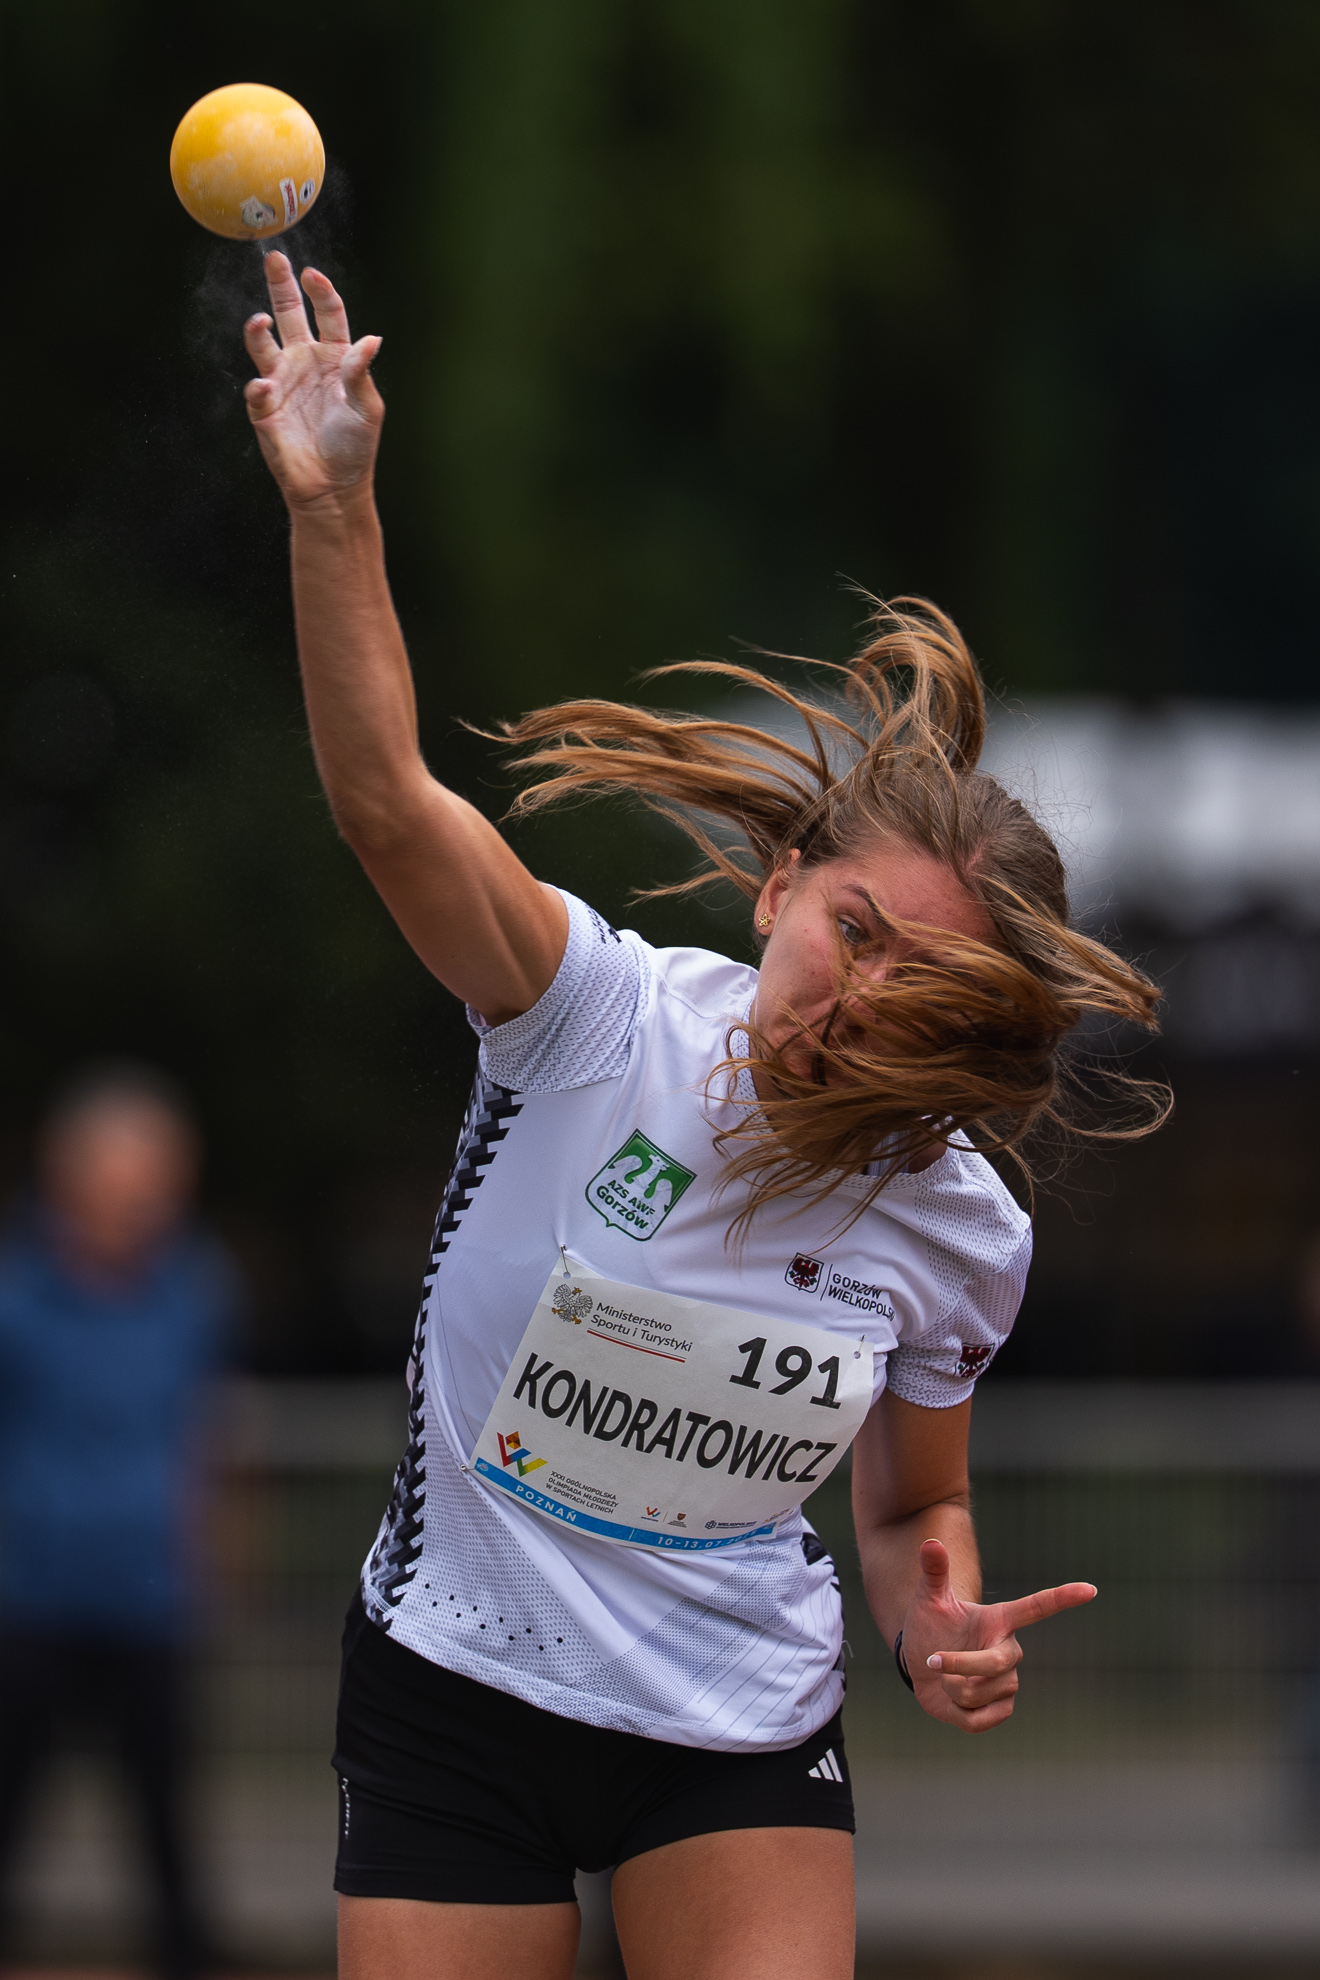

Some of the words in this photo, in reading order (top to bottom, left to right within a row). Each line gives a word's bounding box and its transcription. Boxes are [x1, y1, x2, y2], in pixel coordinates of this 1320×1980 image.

[608, 1180, 629, 1199] AZS
[628, 1197, 655, 1216] AWF
[832, 1273, 882, 1300] GORZÓW
[591, 1314, 630, 1335] Sportu
[632, 1327, 638, 1337] i
[640, 1329, 693, 1352] Turystyki
[596, 1302, 672, 1332] Ministerstwo
[729, 1337, 842, 1410] 191
[513, 1352, 838, 1482] KONDRATOWICZ
[548, 1477, 582, 1497] OLIMPIADA
[550, 1470, 565, 1481] XXXI
[566, 1477, 616, 1501] OGÓLNOPOLSKA
[553, 1486, 585, 1505] SPORTACH
[586, 1502, 614, 1515] LETNICH
[515, 1484, 577, 1522] POZNAŃ
